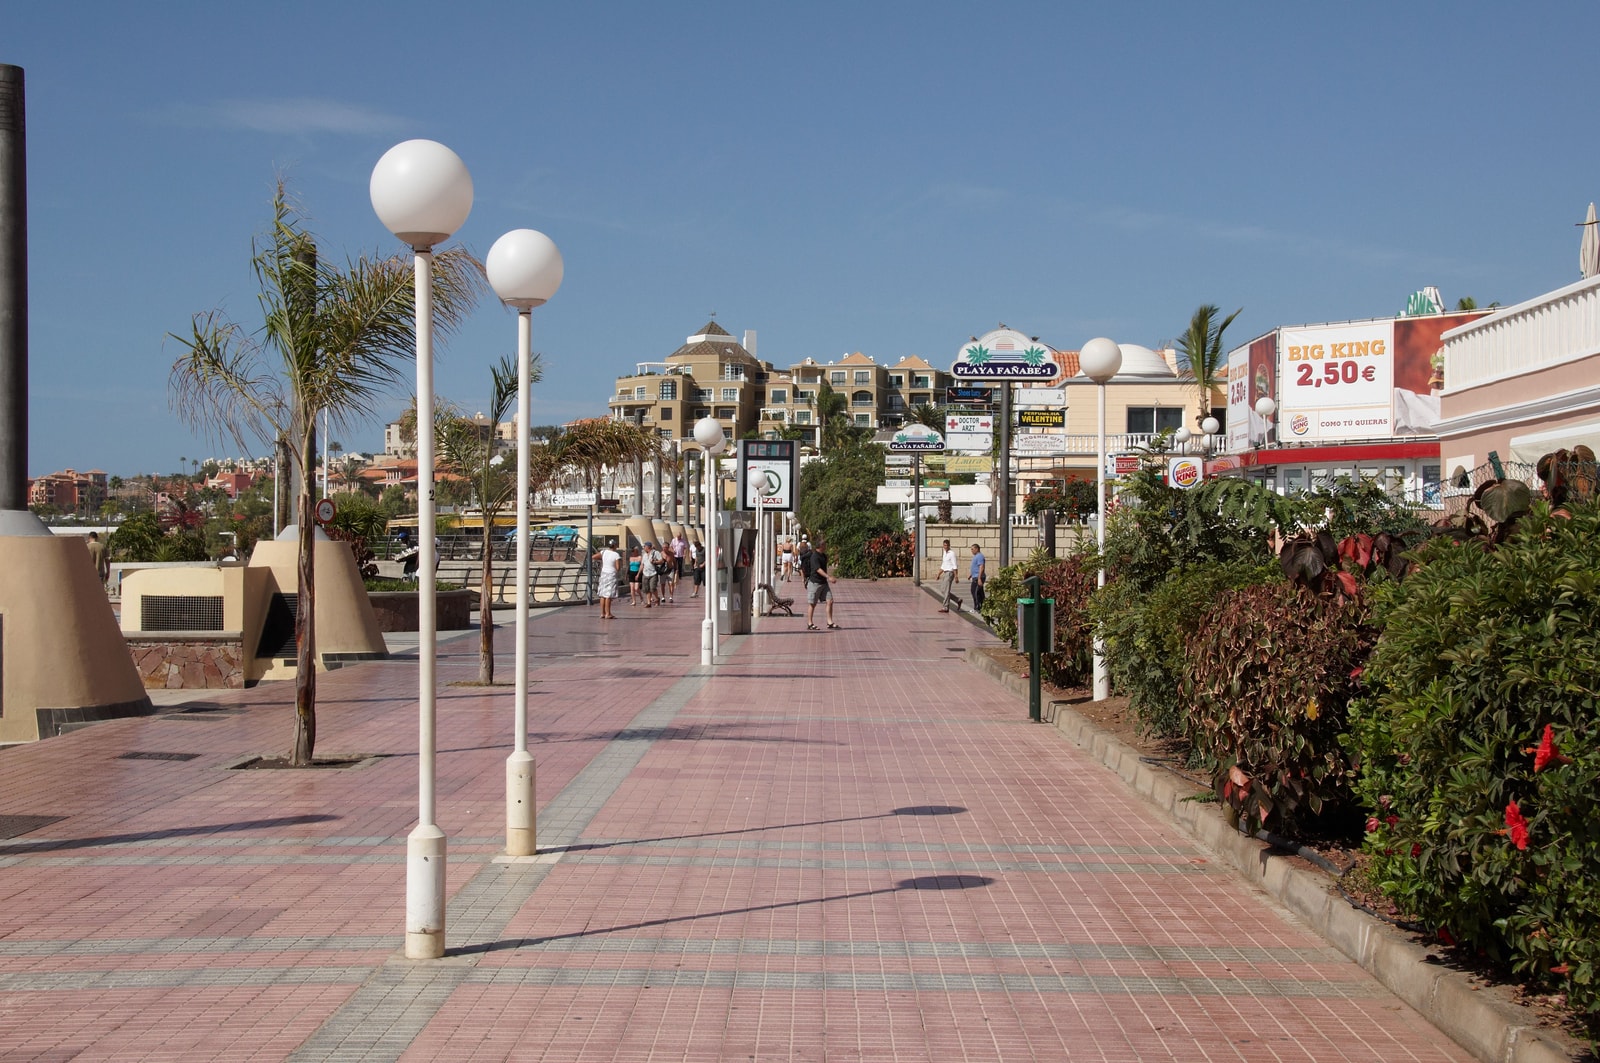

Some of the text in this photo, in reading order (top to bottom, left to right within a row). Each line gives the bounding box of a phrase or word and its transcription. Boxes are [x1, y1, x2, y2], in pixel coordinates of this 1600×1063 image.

[1288, 340, 1386, 361] BIG KING
[957, 367, 994, 375] PLAYA
[1293, 420, 1308, 430] KING
[1175, 466, 1196, 476] BURGER
[1176, 471, 1197, 482] KING
